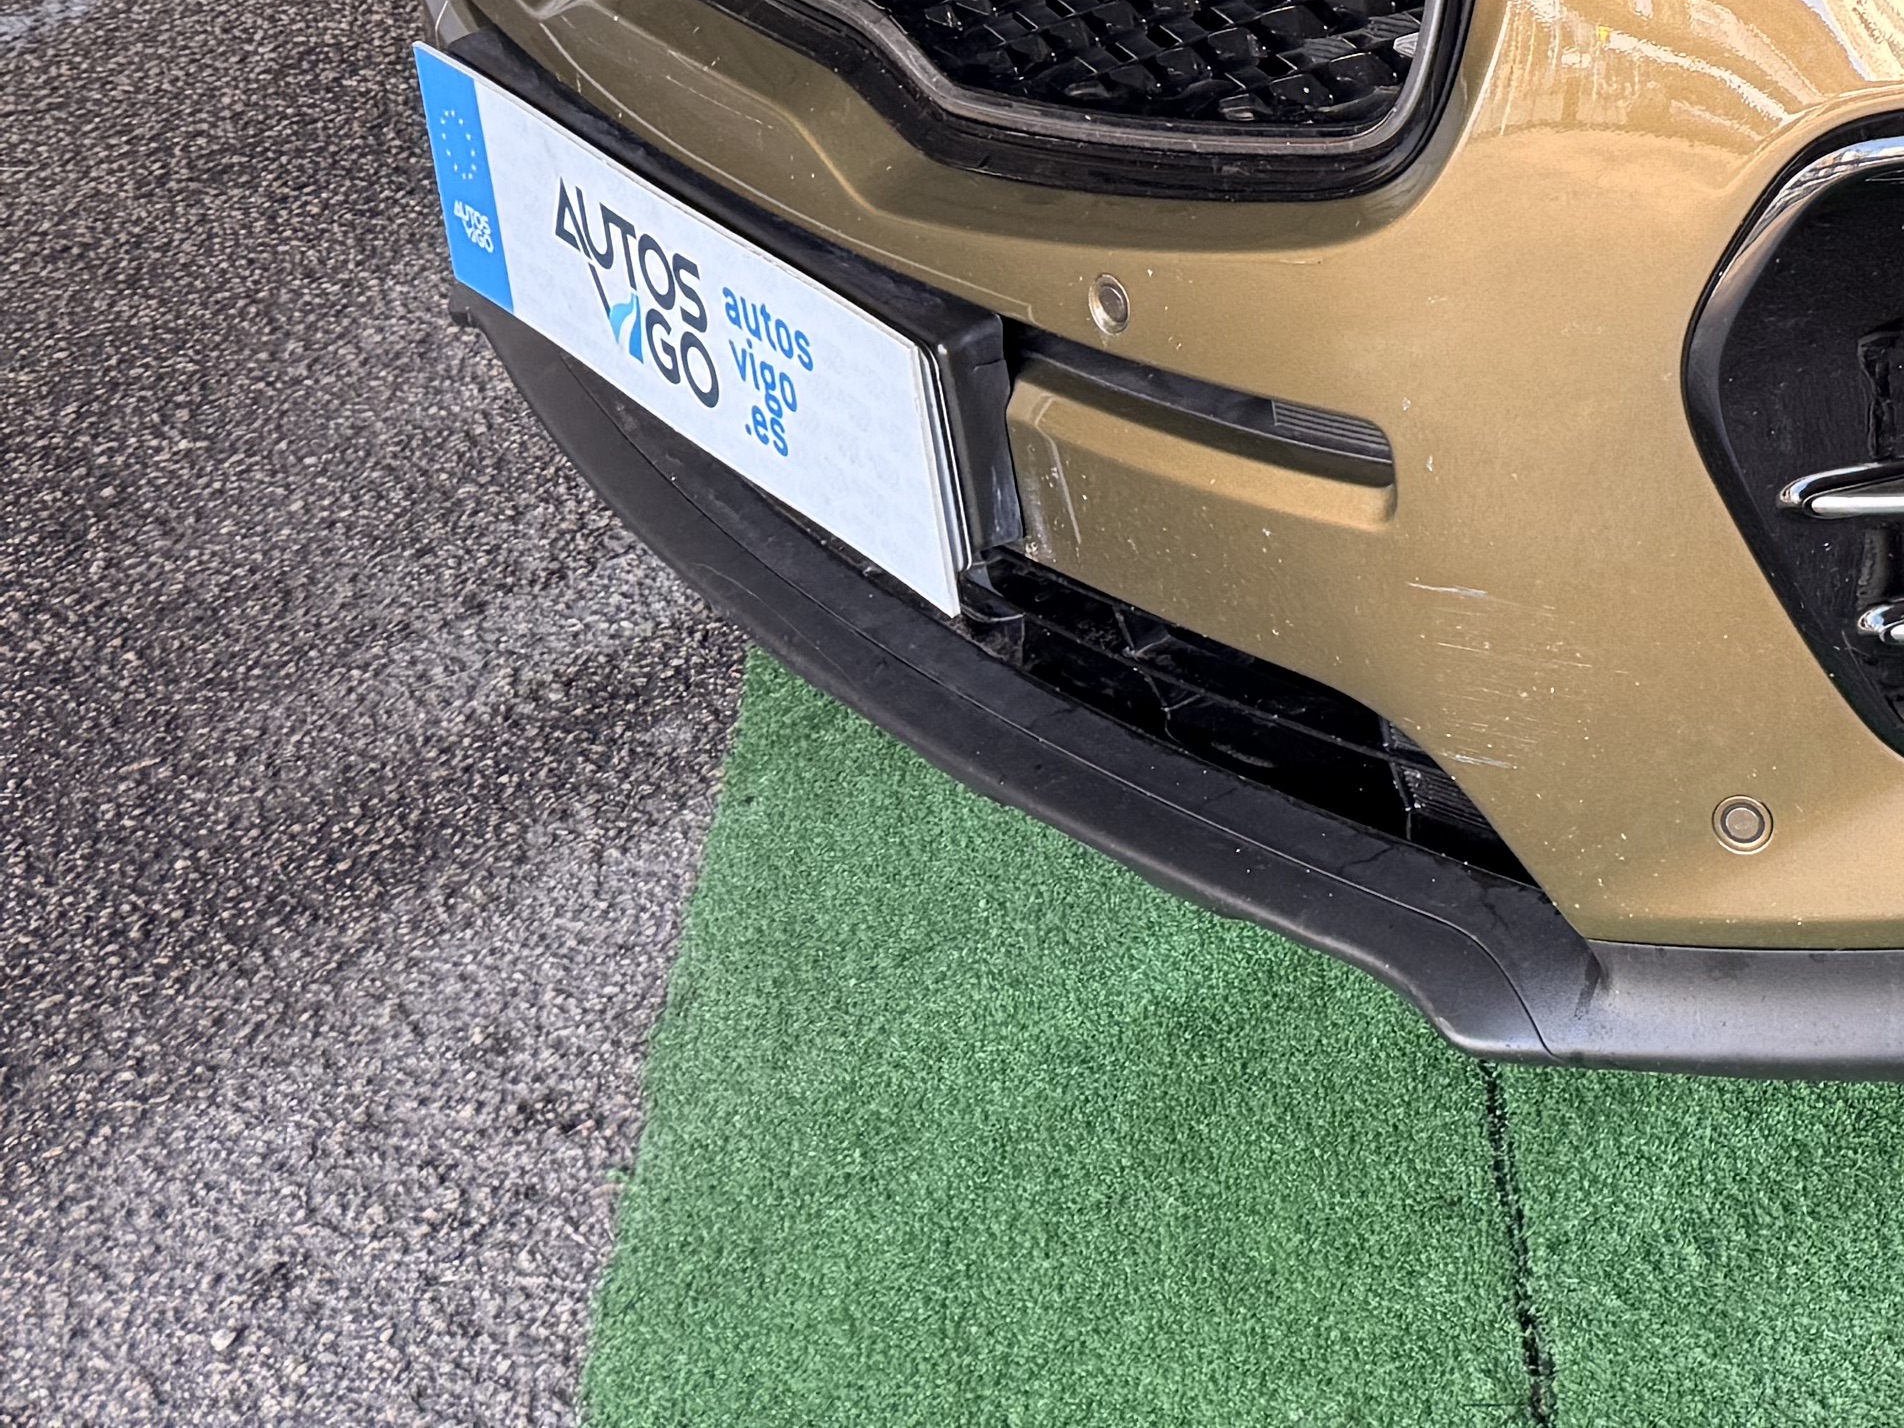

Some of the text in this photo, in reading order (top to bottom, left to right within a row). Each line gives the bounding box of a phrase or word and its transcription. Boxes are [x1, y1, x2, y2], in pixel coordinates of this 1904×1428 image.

[453, 199, 492, 235] AUTOS
[462, 219, 495, 254] VIGO
[555, 177, 709, 336] AUTOS
[588, 263, 720, 409] VIGO
[723, 285, 814, 373] autos
[730, 339, 799, 421] vigo
[744, 403, 789, 458] .es
